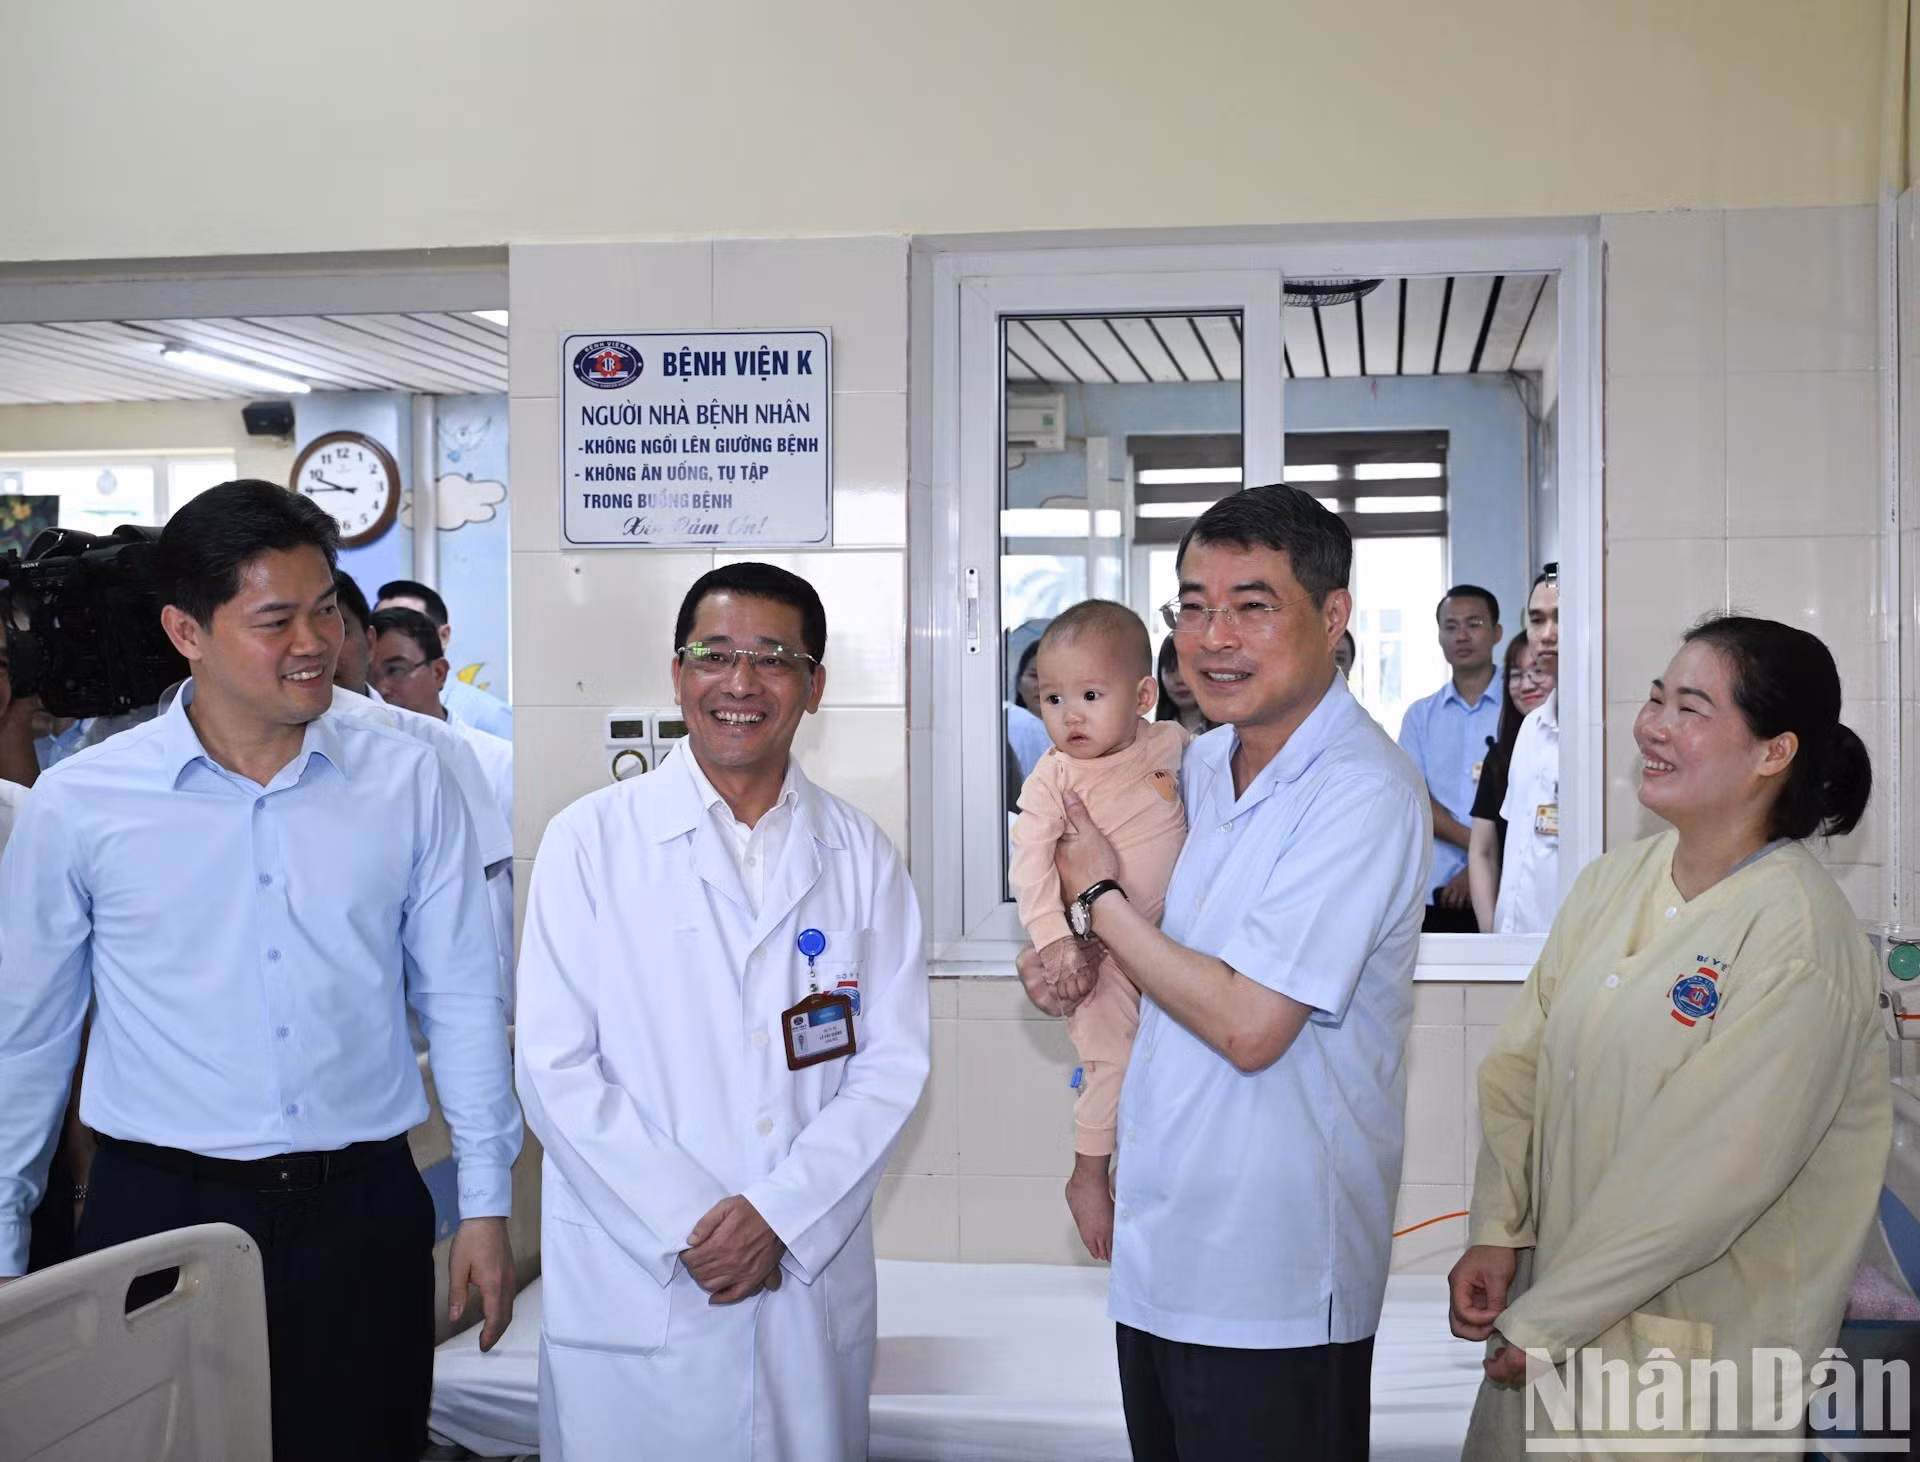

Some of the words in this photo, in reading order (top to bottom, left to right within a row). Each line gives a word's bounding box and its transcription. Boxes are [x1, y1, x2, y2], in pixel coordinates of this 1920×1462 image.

[663, 346, 726, 382] BỆNH
[734, 345, 788, 381] VIỆN
[797, 350, 812, 375] K
[581, 398, 642, 426] NGƯỜI
[649, 398, 690, 425] NHÀ
[697, 398, 748, 430] BỆNH
[755, 398, 810, 425] NHÂN
[641, 433, 677, 454] NGỒI
[682, 435, 710, 453] LÊN
[715, 434, 772, 453] GIƯỜNG
[777, 434, 819, 456] BỆNH
[321, 454, 331, 465] 11
[336, 448, 349, 459] 12
[358, 451, 363, 462] 1
[369, 463, 377, 474] 2
[585, 463, 636, 482] KHÔNG
[641, 463, 662, 481] ĂN
[667, 460, 713, 483] UỐNG,
[717, 465, 737, 484] TỤ
[740, 462, 769, 484] TẬP
[309, 469, 324, 481] 10
[372, 500, 379, 510] 4
[583, 493, 633, 509] TRONG
[692, 490, 733, 512] BỆNH
[360, 513, 368, 525] 5
